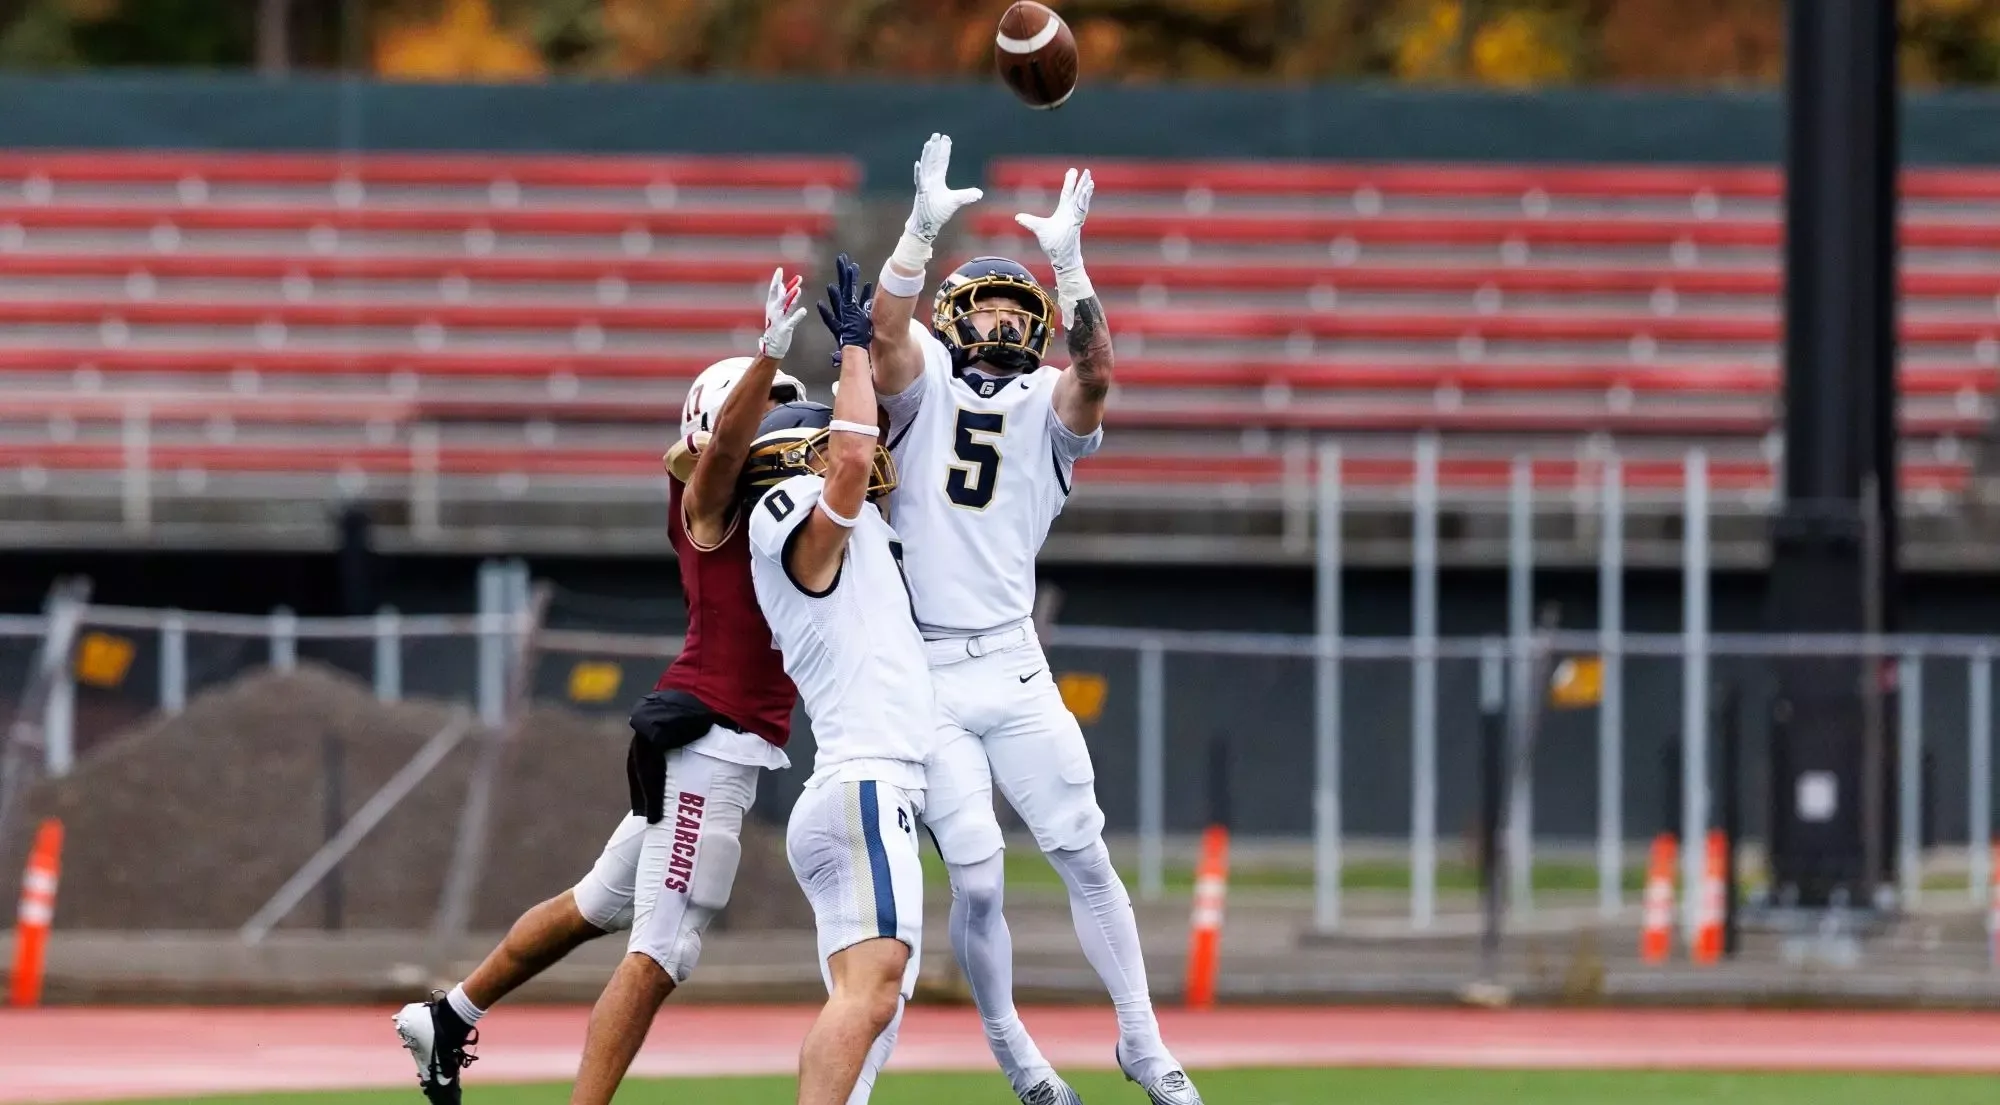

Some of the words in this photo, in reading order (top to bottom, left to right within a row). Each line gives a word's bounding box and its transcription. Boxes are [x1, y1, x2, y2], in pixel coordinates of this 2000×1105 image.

[686, 384, 704, 422] 17
[944, 405, 1007, 512] 5
[764, 489, 795, 523] 0
[665, 791, 705, 894] BEARCATS
